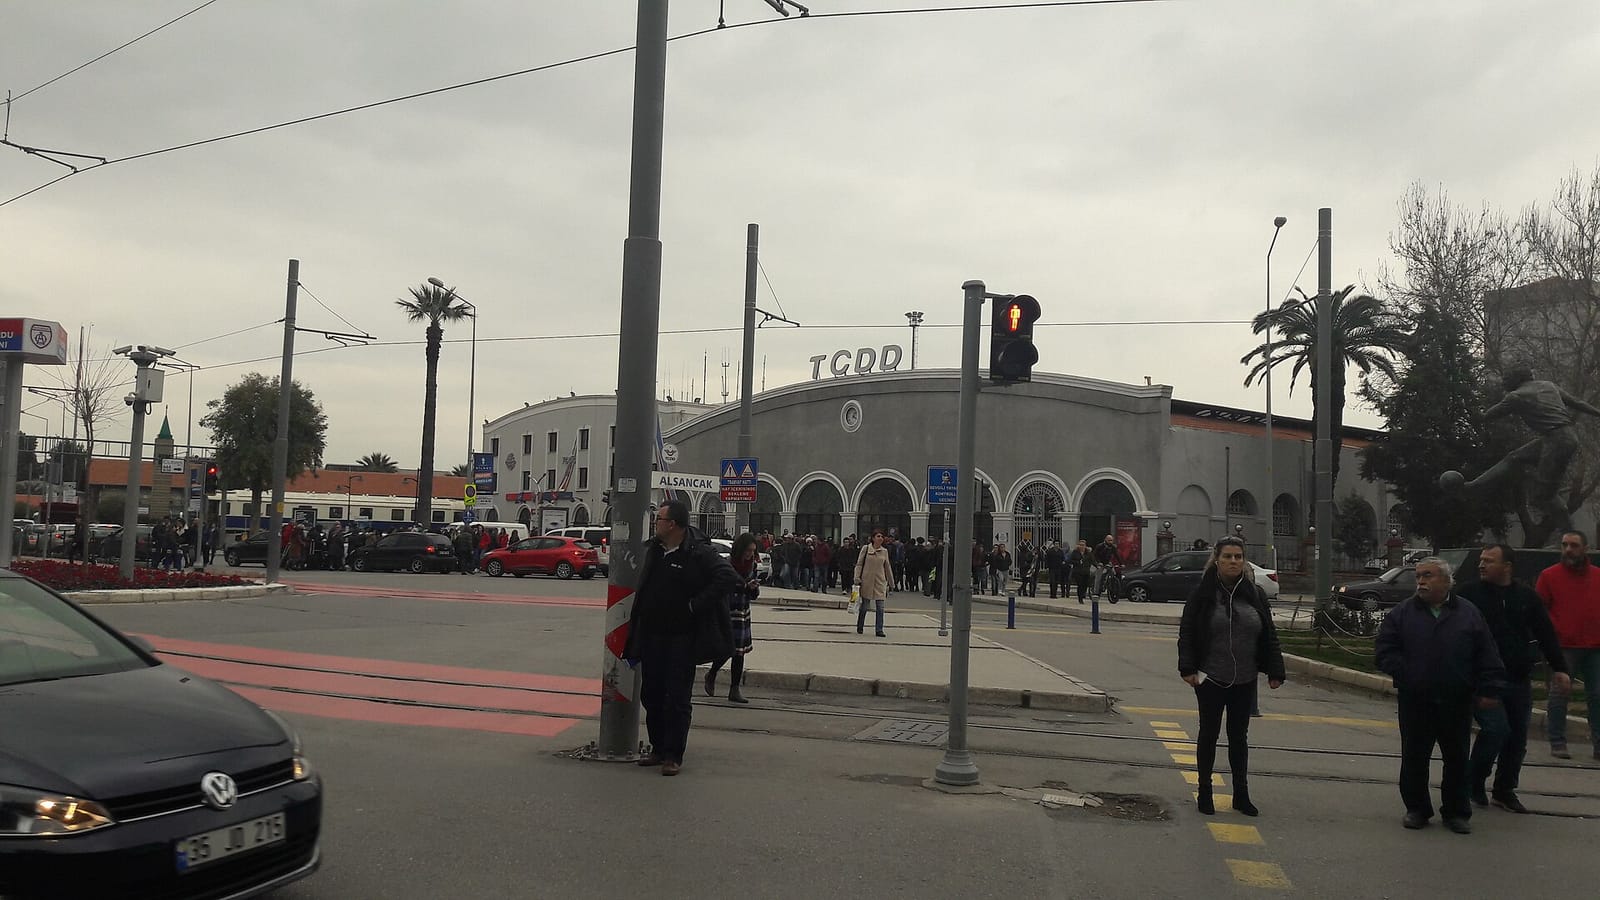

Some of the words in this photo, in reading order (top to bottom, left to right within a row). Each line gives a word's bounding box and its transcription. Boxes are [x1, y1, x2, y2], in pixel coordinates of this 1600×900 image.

[810, 345, 902, 379] TCDD
[659, 476, 712, 489] ALSANCAK
[189, 835, 211, 861] 35
